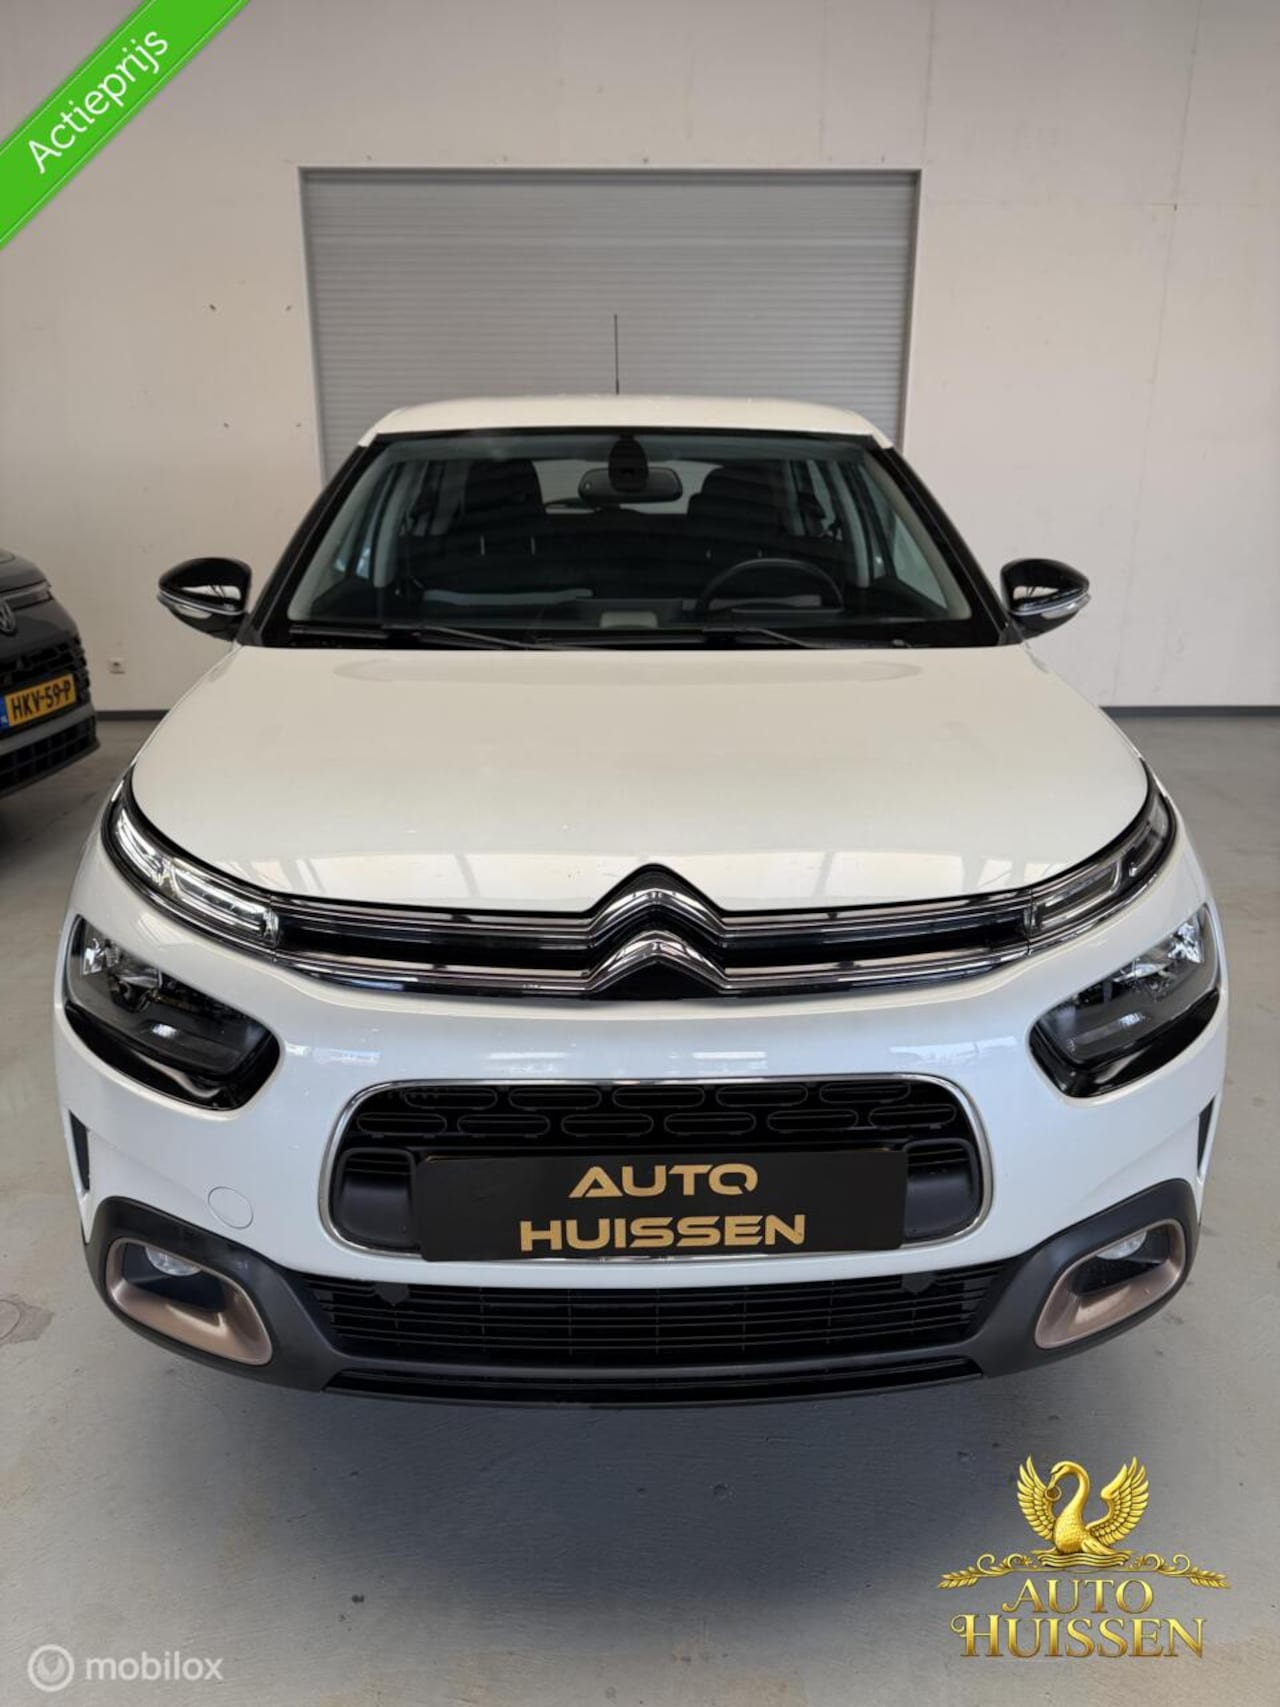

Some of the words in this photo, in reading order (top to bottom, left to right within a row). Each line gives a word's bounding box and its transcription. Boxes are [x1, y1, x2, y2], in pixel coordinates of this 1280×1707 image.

[11, 680, 71, 720] HKV-59-P
[569, 1163, 759, 1198] AUTO
[520, 1214, 806, 1252] HUISSEN
